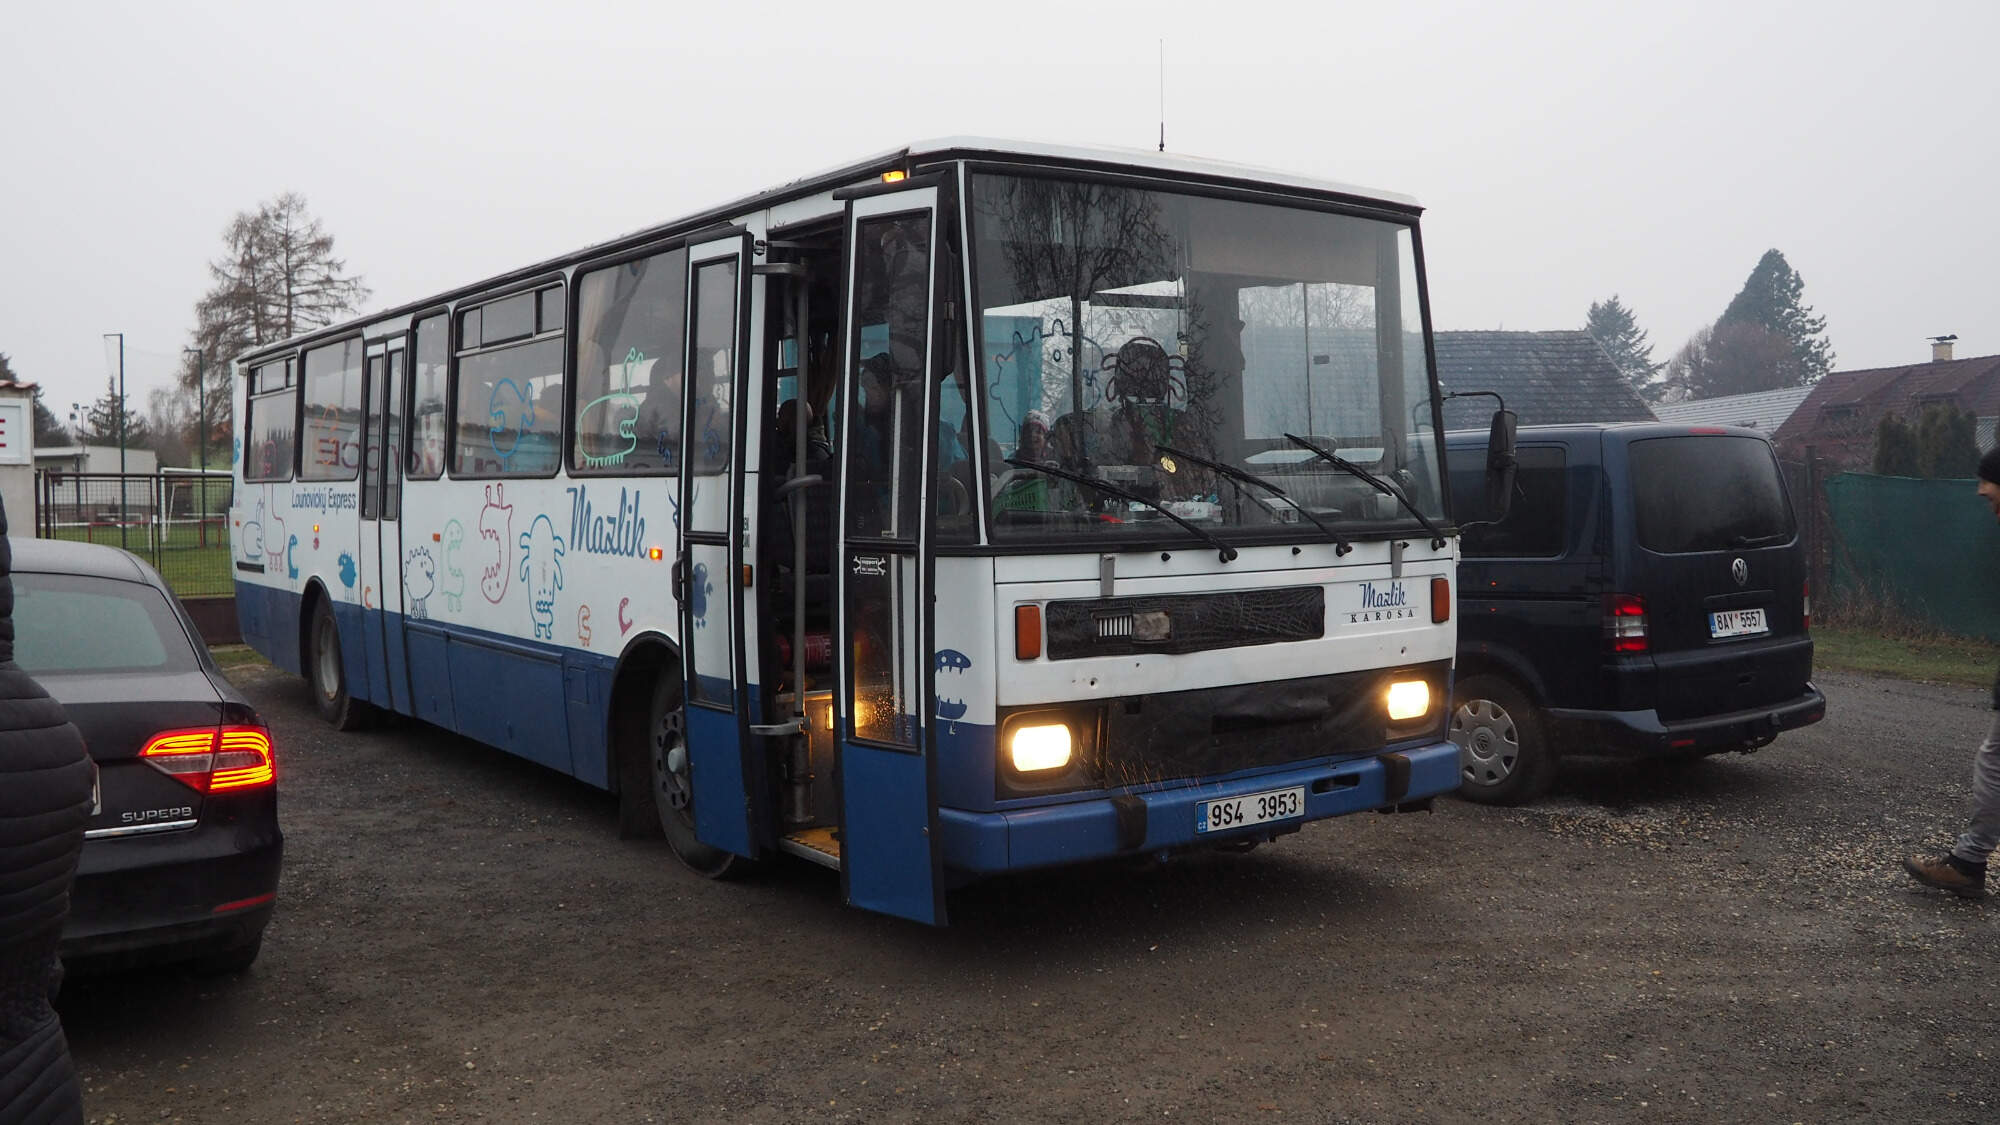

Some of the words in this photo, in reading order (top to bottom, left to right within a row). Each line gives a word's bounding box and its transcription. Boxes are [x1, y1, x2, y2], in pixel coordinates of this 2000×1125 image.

[328, 488, 357, 515] Express
[1350, 609, 1414, 623] KAROSA
[1717, 612, 1733, 630] 8AY
[1740, 610, 1761, 627] 5557
[121, 806, 193, 823] SUPERB
[1212, 801, 1243, 827] 9S4
[1258, 792, 1297, 819] 3953
